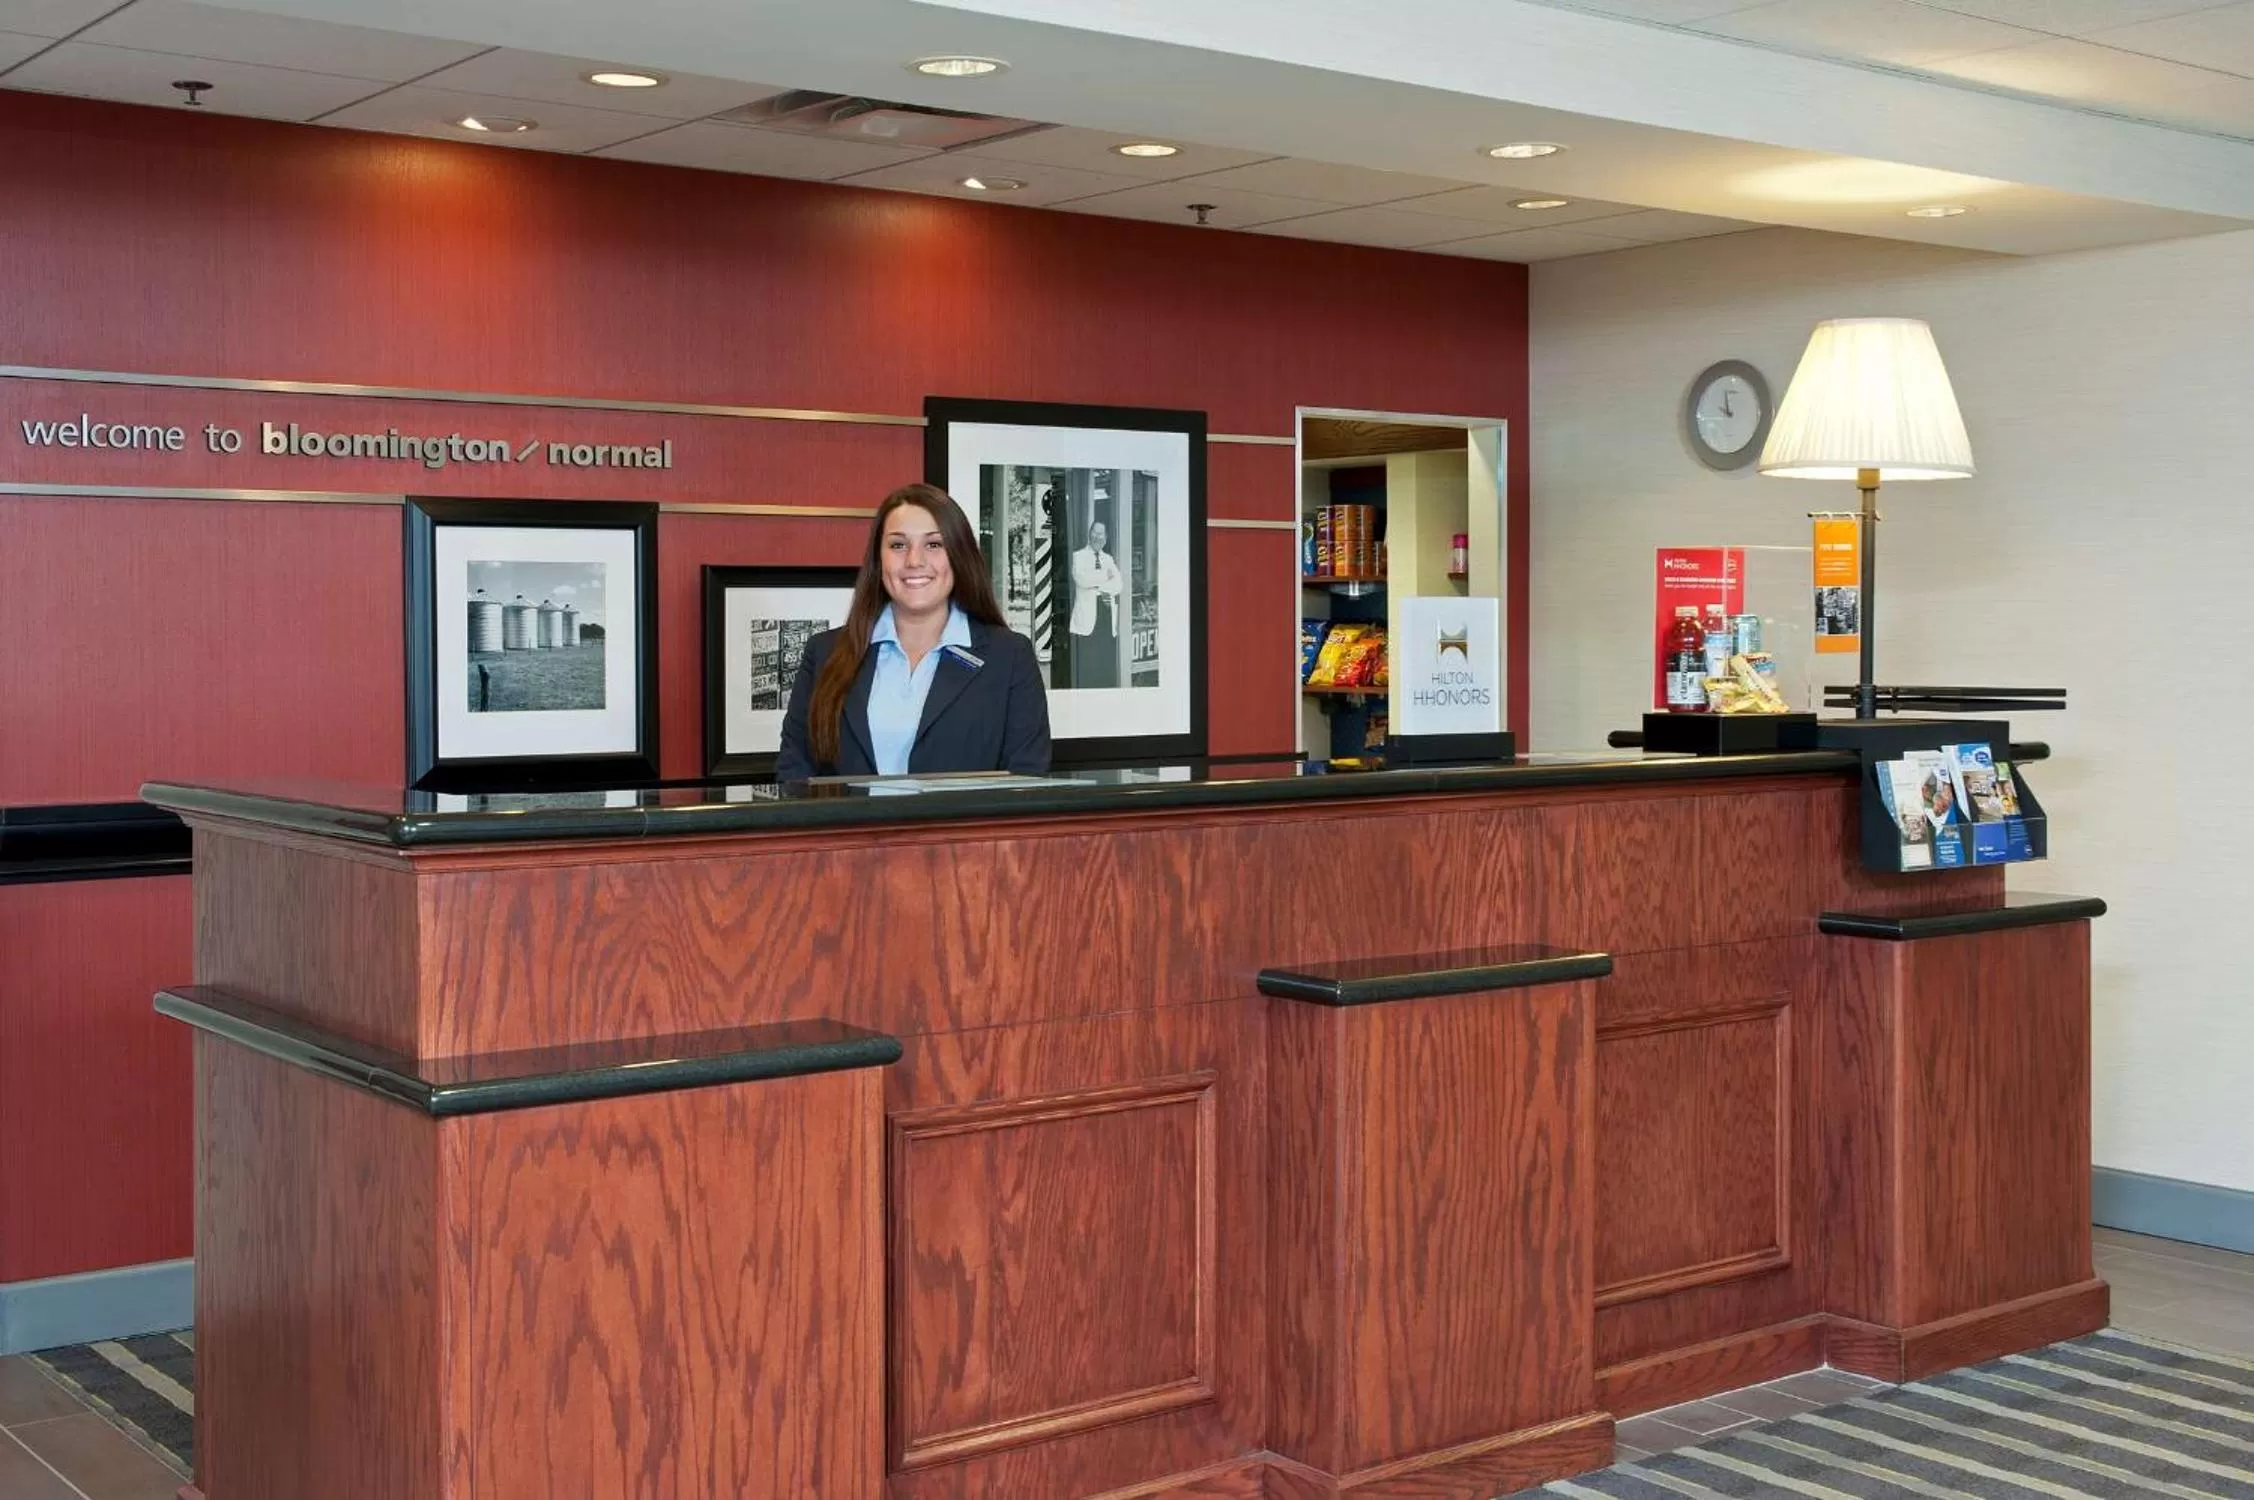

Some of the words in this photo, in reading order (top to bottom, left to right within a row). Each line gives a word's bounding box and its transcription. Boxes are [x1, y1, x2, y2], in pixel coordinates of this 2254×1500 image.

[21, 412, 186, 451] welcome
[203, 422, 243, 453] to
[261, 421, 511, 470] bloomington
[546, 438, 674, 470] normal
[1431, 671, 1475, 685] HILTON
[1412, 688, 1491, 707] HHONORS
